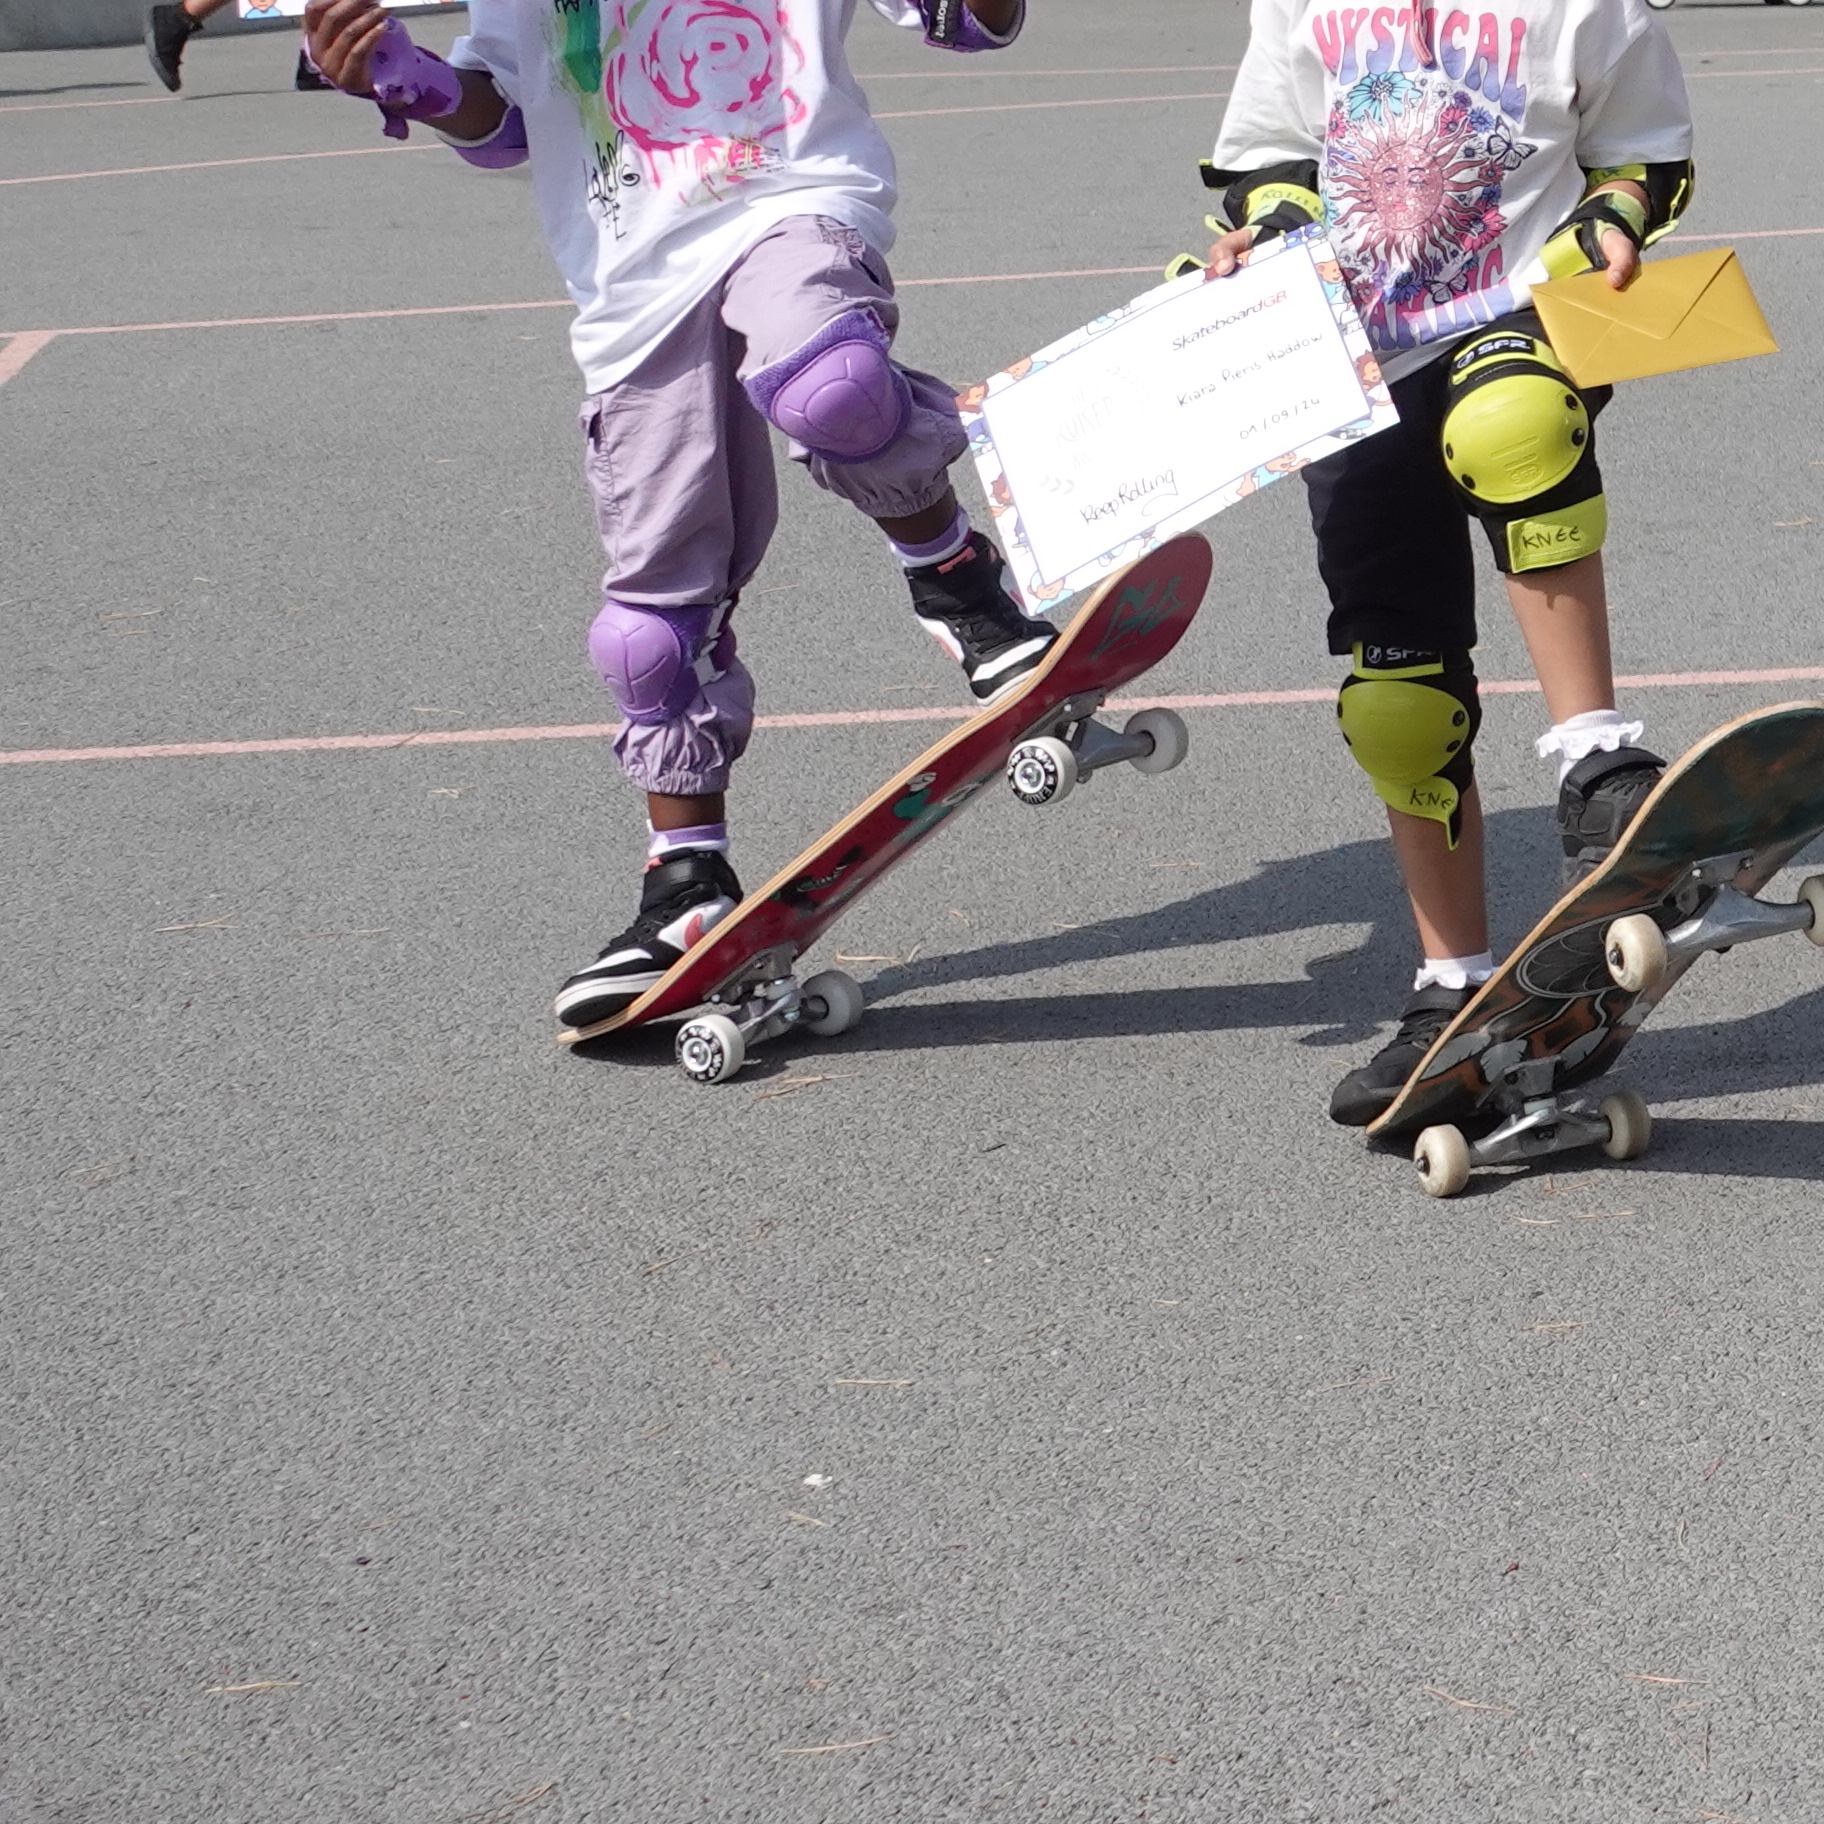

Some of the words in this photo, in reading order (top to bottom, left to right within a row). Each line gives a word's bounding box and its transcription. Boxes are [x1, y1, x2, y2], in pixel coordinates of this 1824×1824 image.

[1171, 290, 1289, 352] SkateboardGB
[1176, 383, 1217, 409] Kiara
[1522, 526, 1582, 550] KNEE
